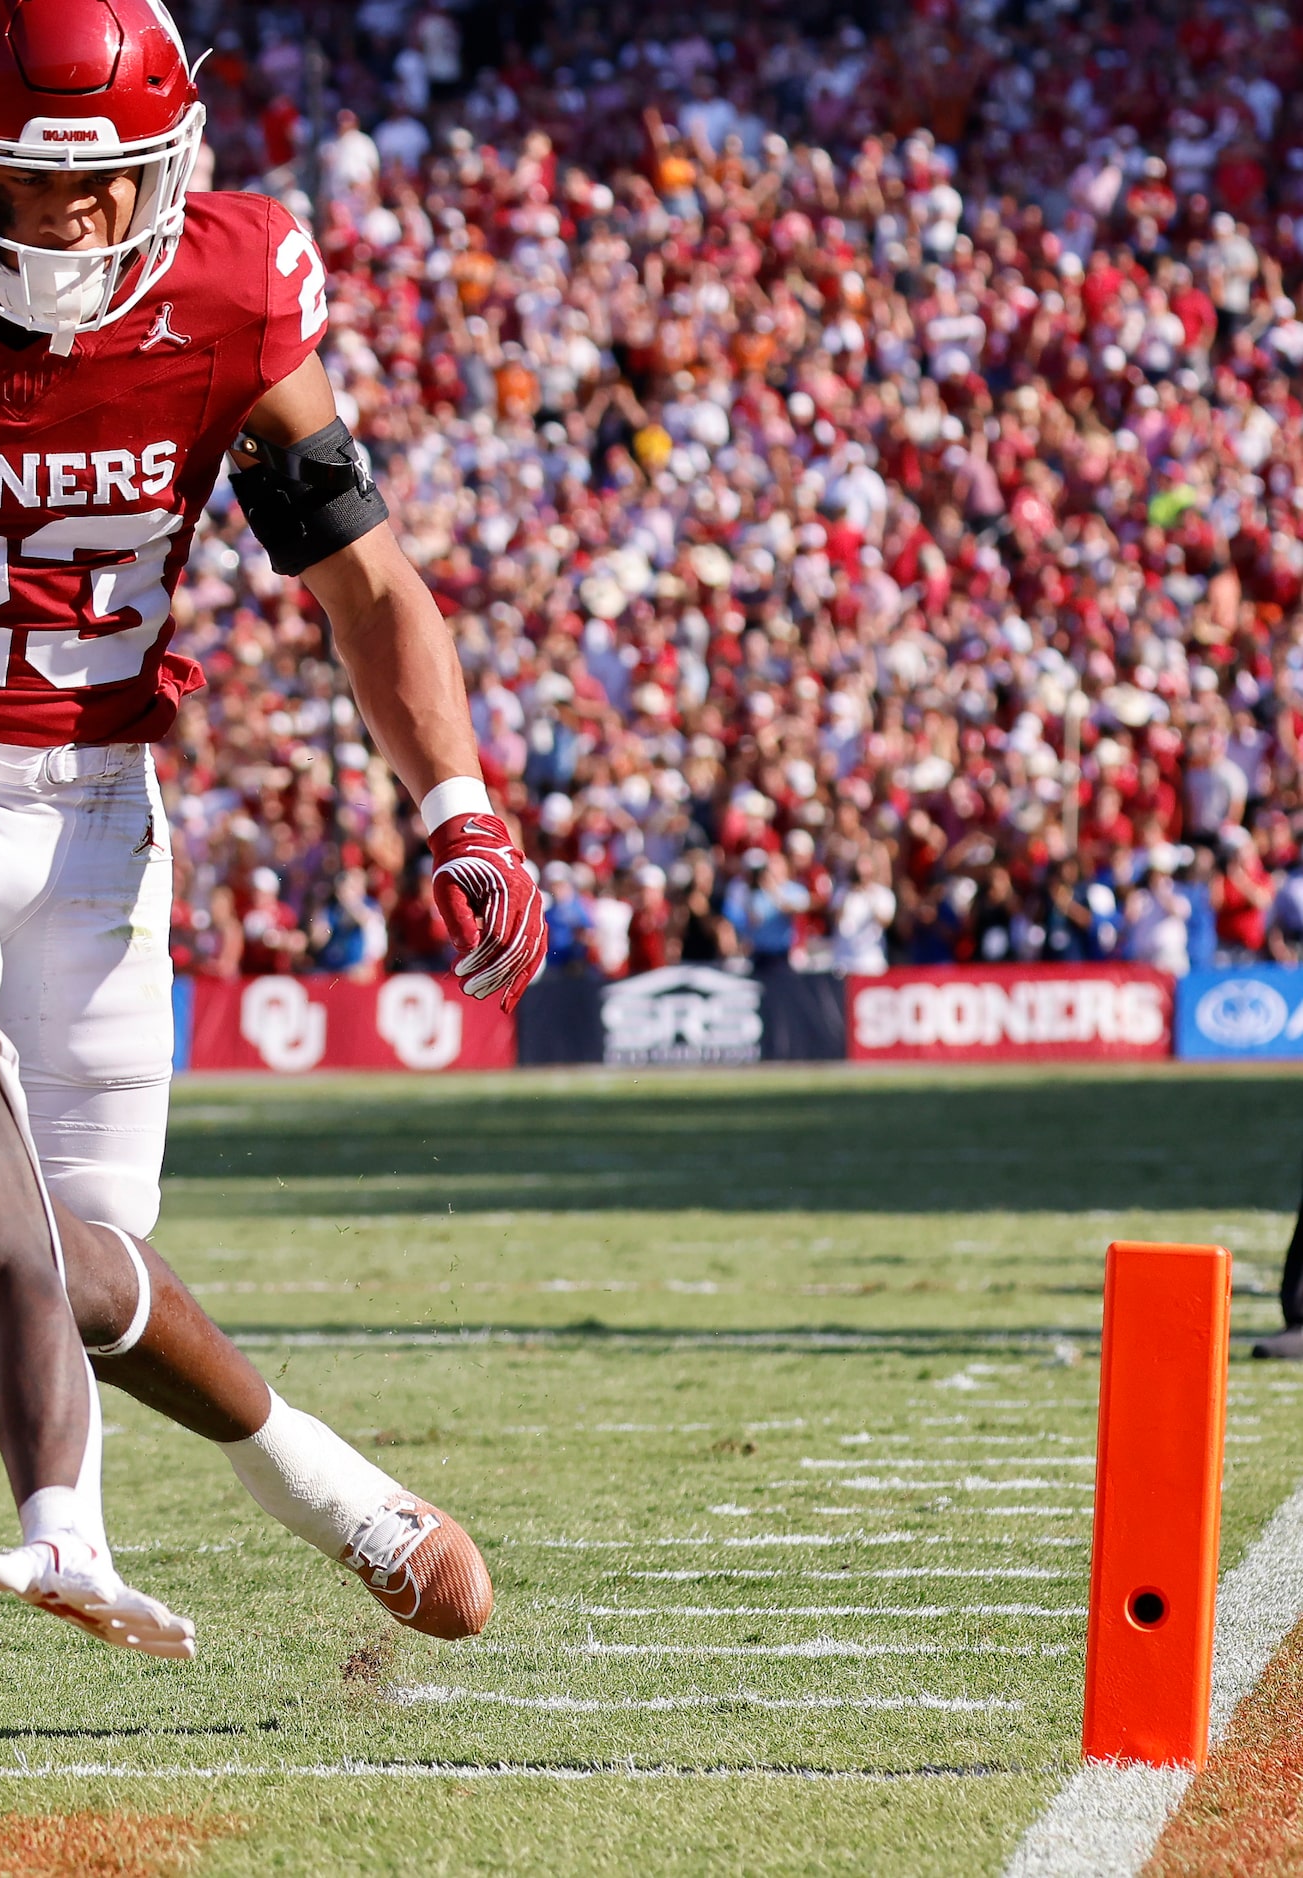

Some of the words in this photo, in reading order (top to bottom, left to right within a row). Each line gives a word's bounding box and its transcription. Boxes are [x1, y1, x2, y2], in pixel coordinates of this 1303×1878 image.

[42, 130, 99, 142] OKLAHOMA
[276, 215, 329, 342] 2
[240, 974, 327, 1071] OU
[376, 972, 462, 1071] OU
[601, 997, 763, 1046] SRS
[853, 980, 1164, 1049] SOONERS
